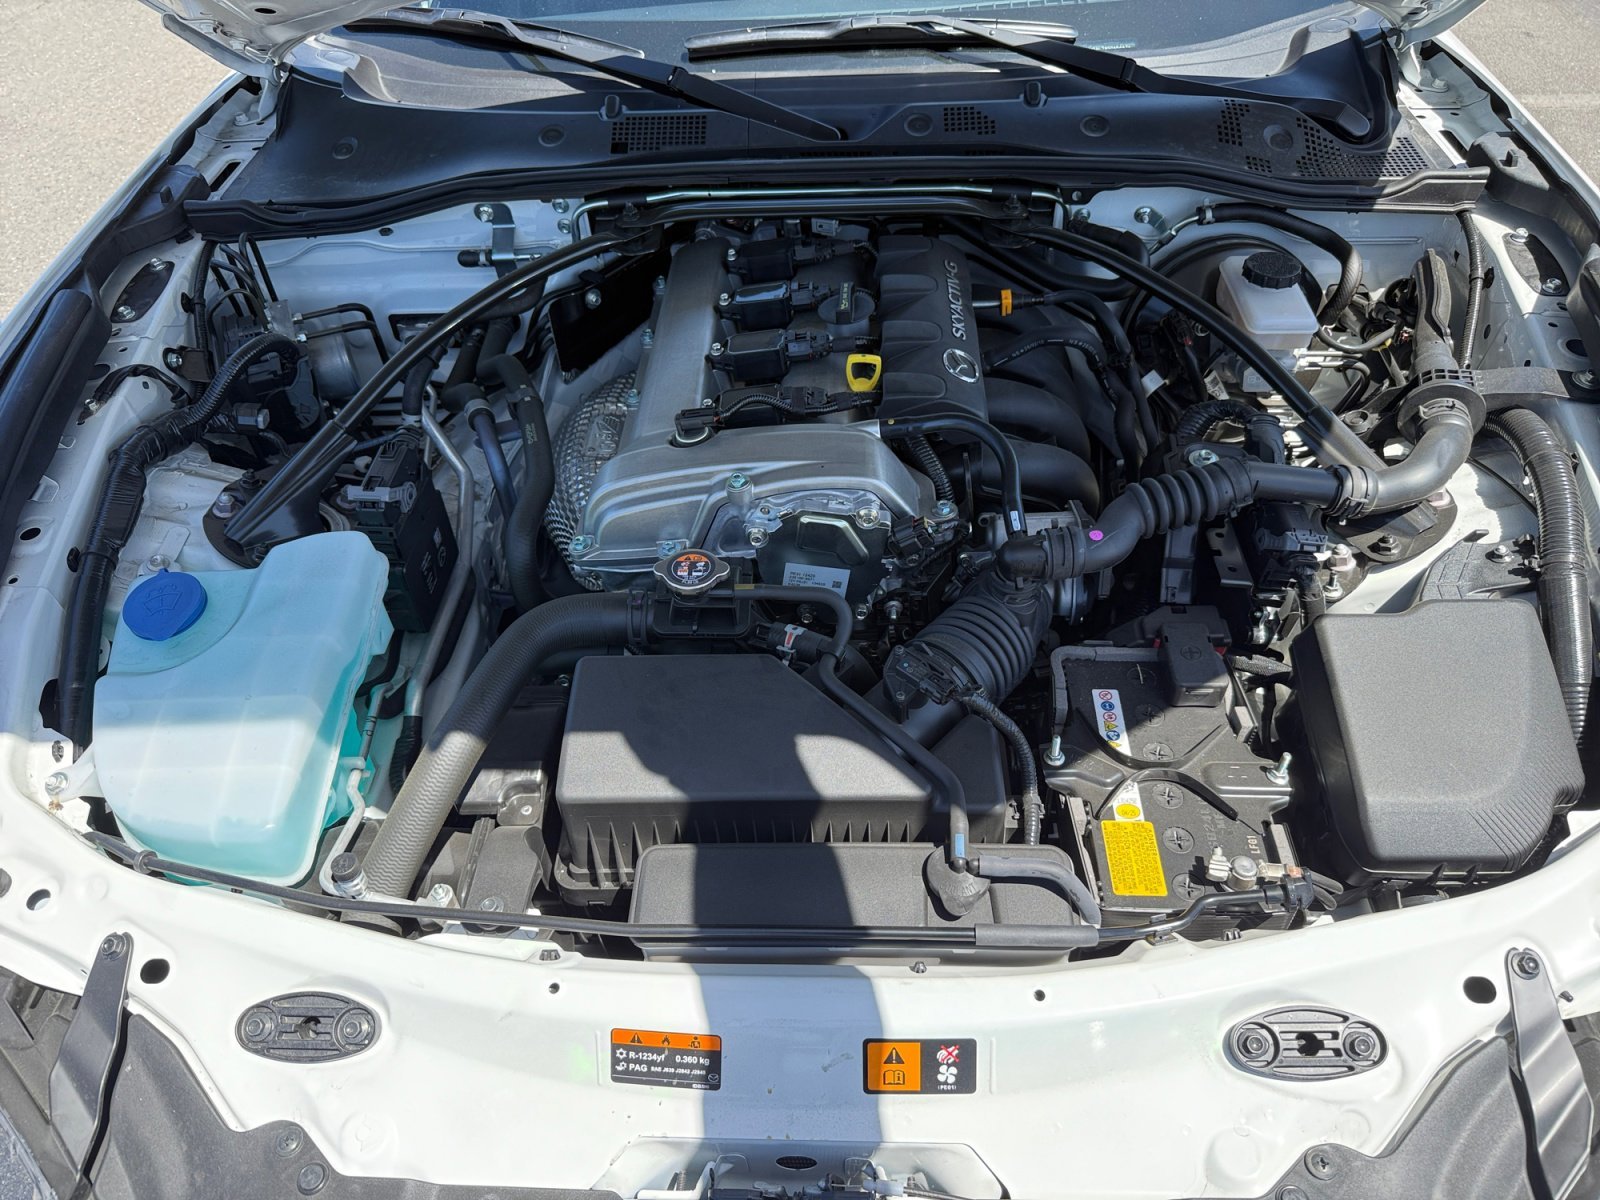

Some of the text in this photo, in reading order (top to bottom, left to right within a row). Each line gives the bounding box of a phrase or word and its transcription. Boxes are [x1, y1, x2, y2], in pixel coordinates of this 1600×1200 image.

[944, 259, 966, 341] SKYACTIV-G
[628, 1051, 710, 1066] R-1234yf 0.360 kg
[628, 1064, 648, 1072] PAG
